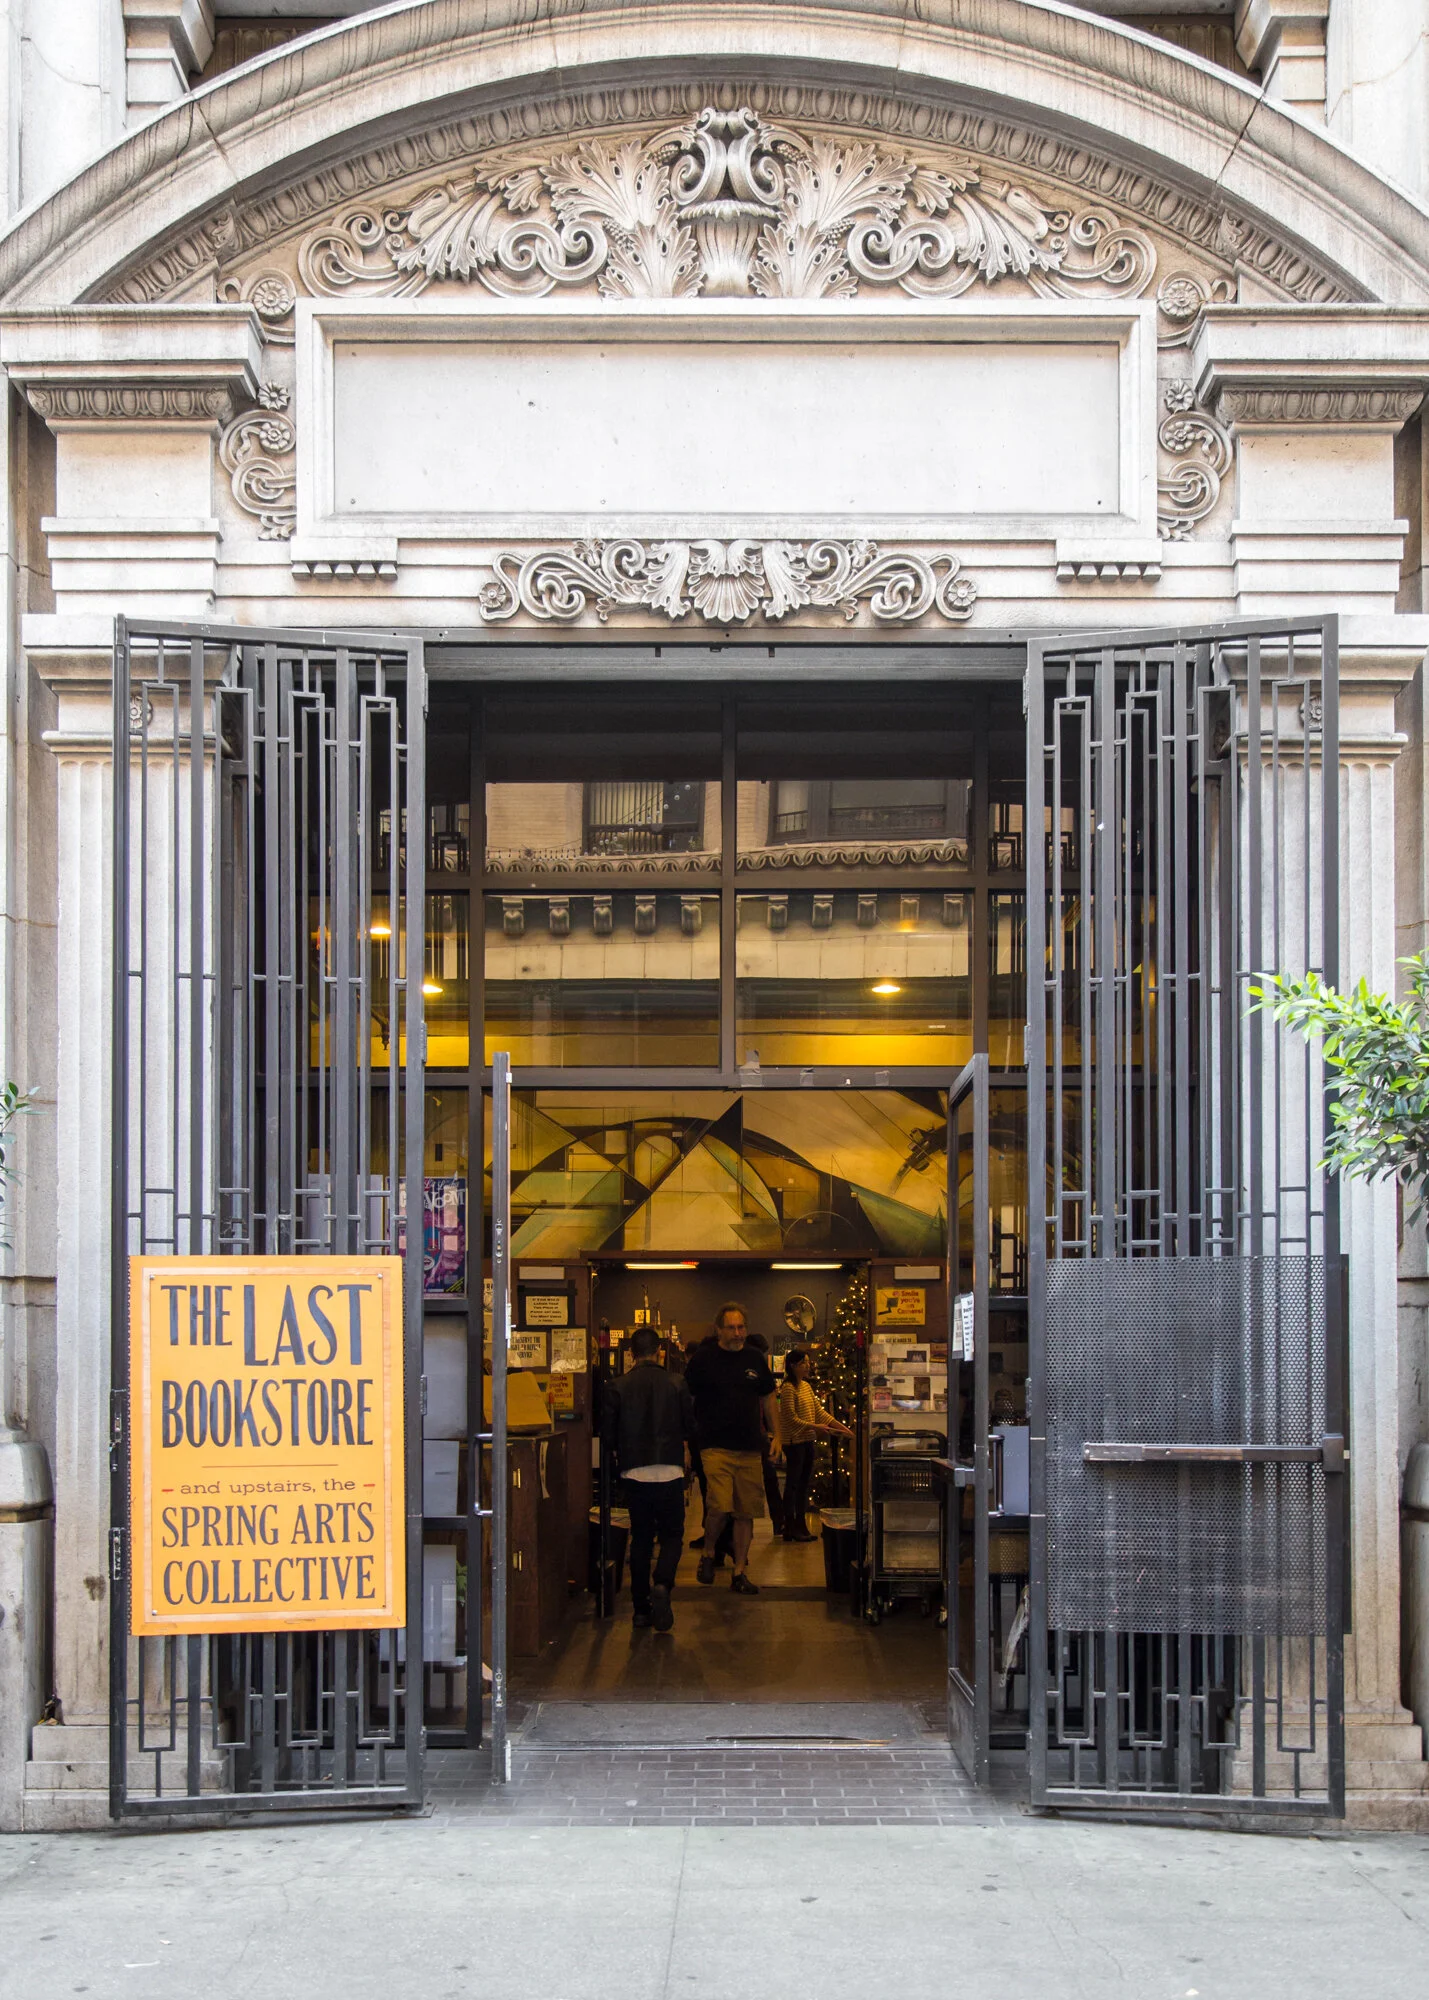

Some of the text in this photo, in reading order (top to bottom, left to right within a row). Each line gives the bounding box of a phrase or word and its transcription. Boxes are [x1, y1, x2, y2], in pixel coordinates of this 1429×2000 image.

[160, 1284, 373, 1366] THE LAST
[162, 1378, 374, 1448] BOOKSTORE
[181, 1478, 356, 1496] and upstairs, the
[162, 1502, 375, 1548] SPRING ARTS
[163, 1555, 376, 1606] COLLECTIVE
